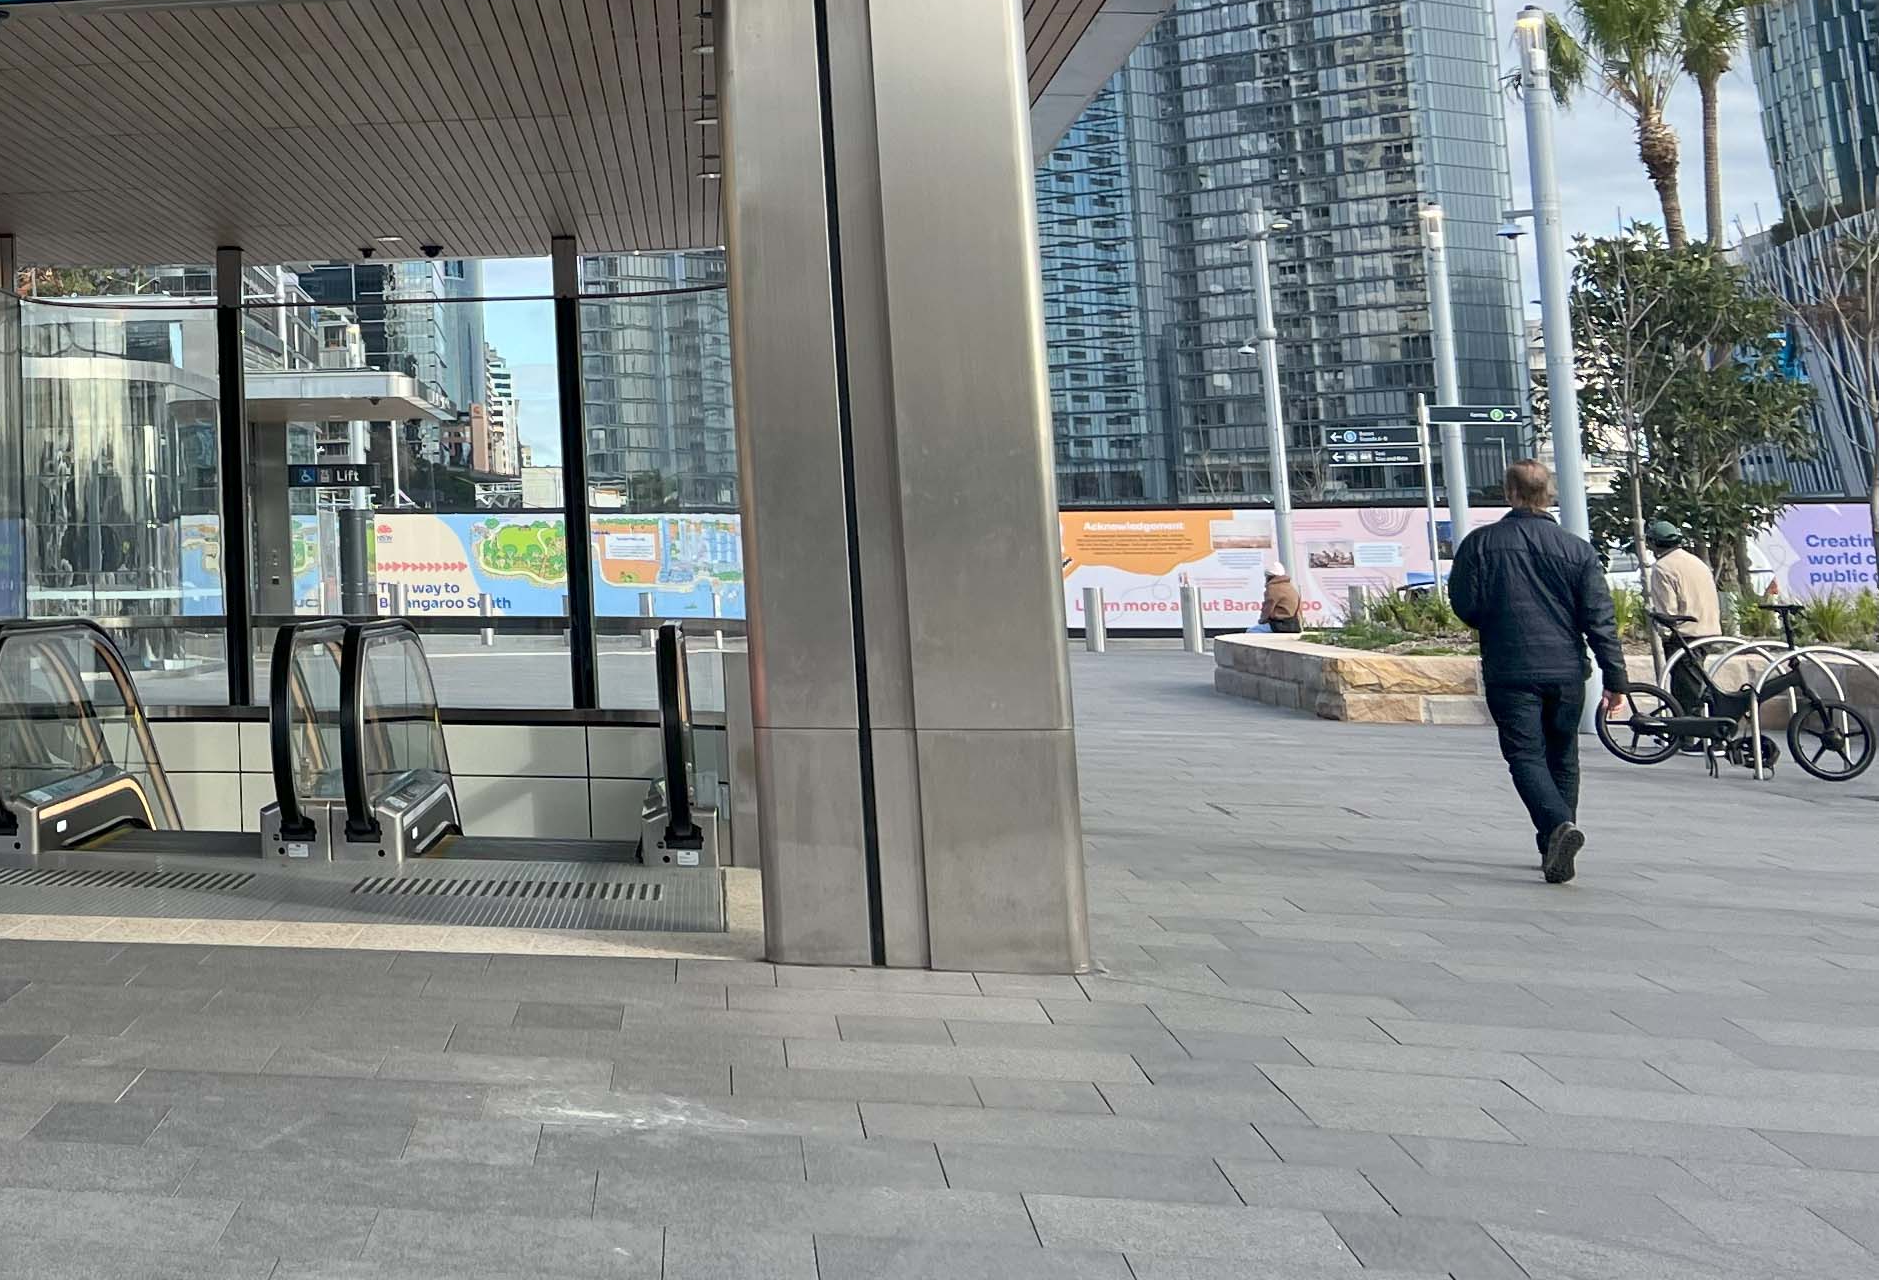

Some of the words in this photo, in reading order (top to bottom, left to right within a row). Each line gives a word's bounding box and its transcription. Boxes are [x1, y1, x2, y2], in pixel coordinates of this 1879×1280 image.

[336, 470, 360, 481] Lift
[1083, 521, 1185, 532] Acknowledgement
[1808, 552, 1862, 565] world
[1810, 570, 1869, 586] public
[412, 583, 442, 596] way
[444, 582, 460, 593] to
[1075, 600, 1120, 612] Lrn
[1124, 601, 1167, 612] more
[1169, 599, 1222, 612] aut
[1223, 599, 1322, 612] Baraoo
